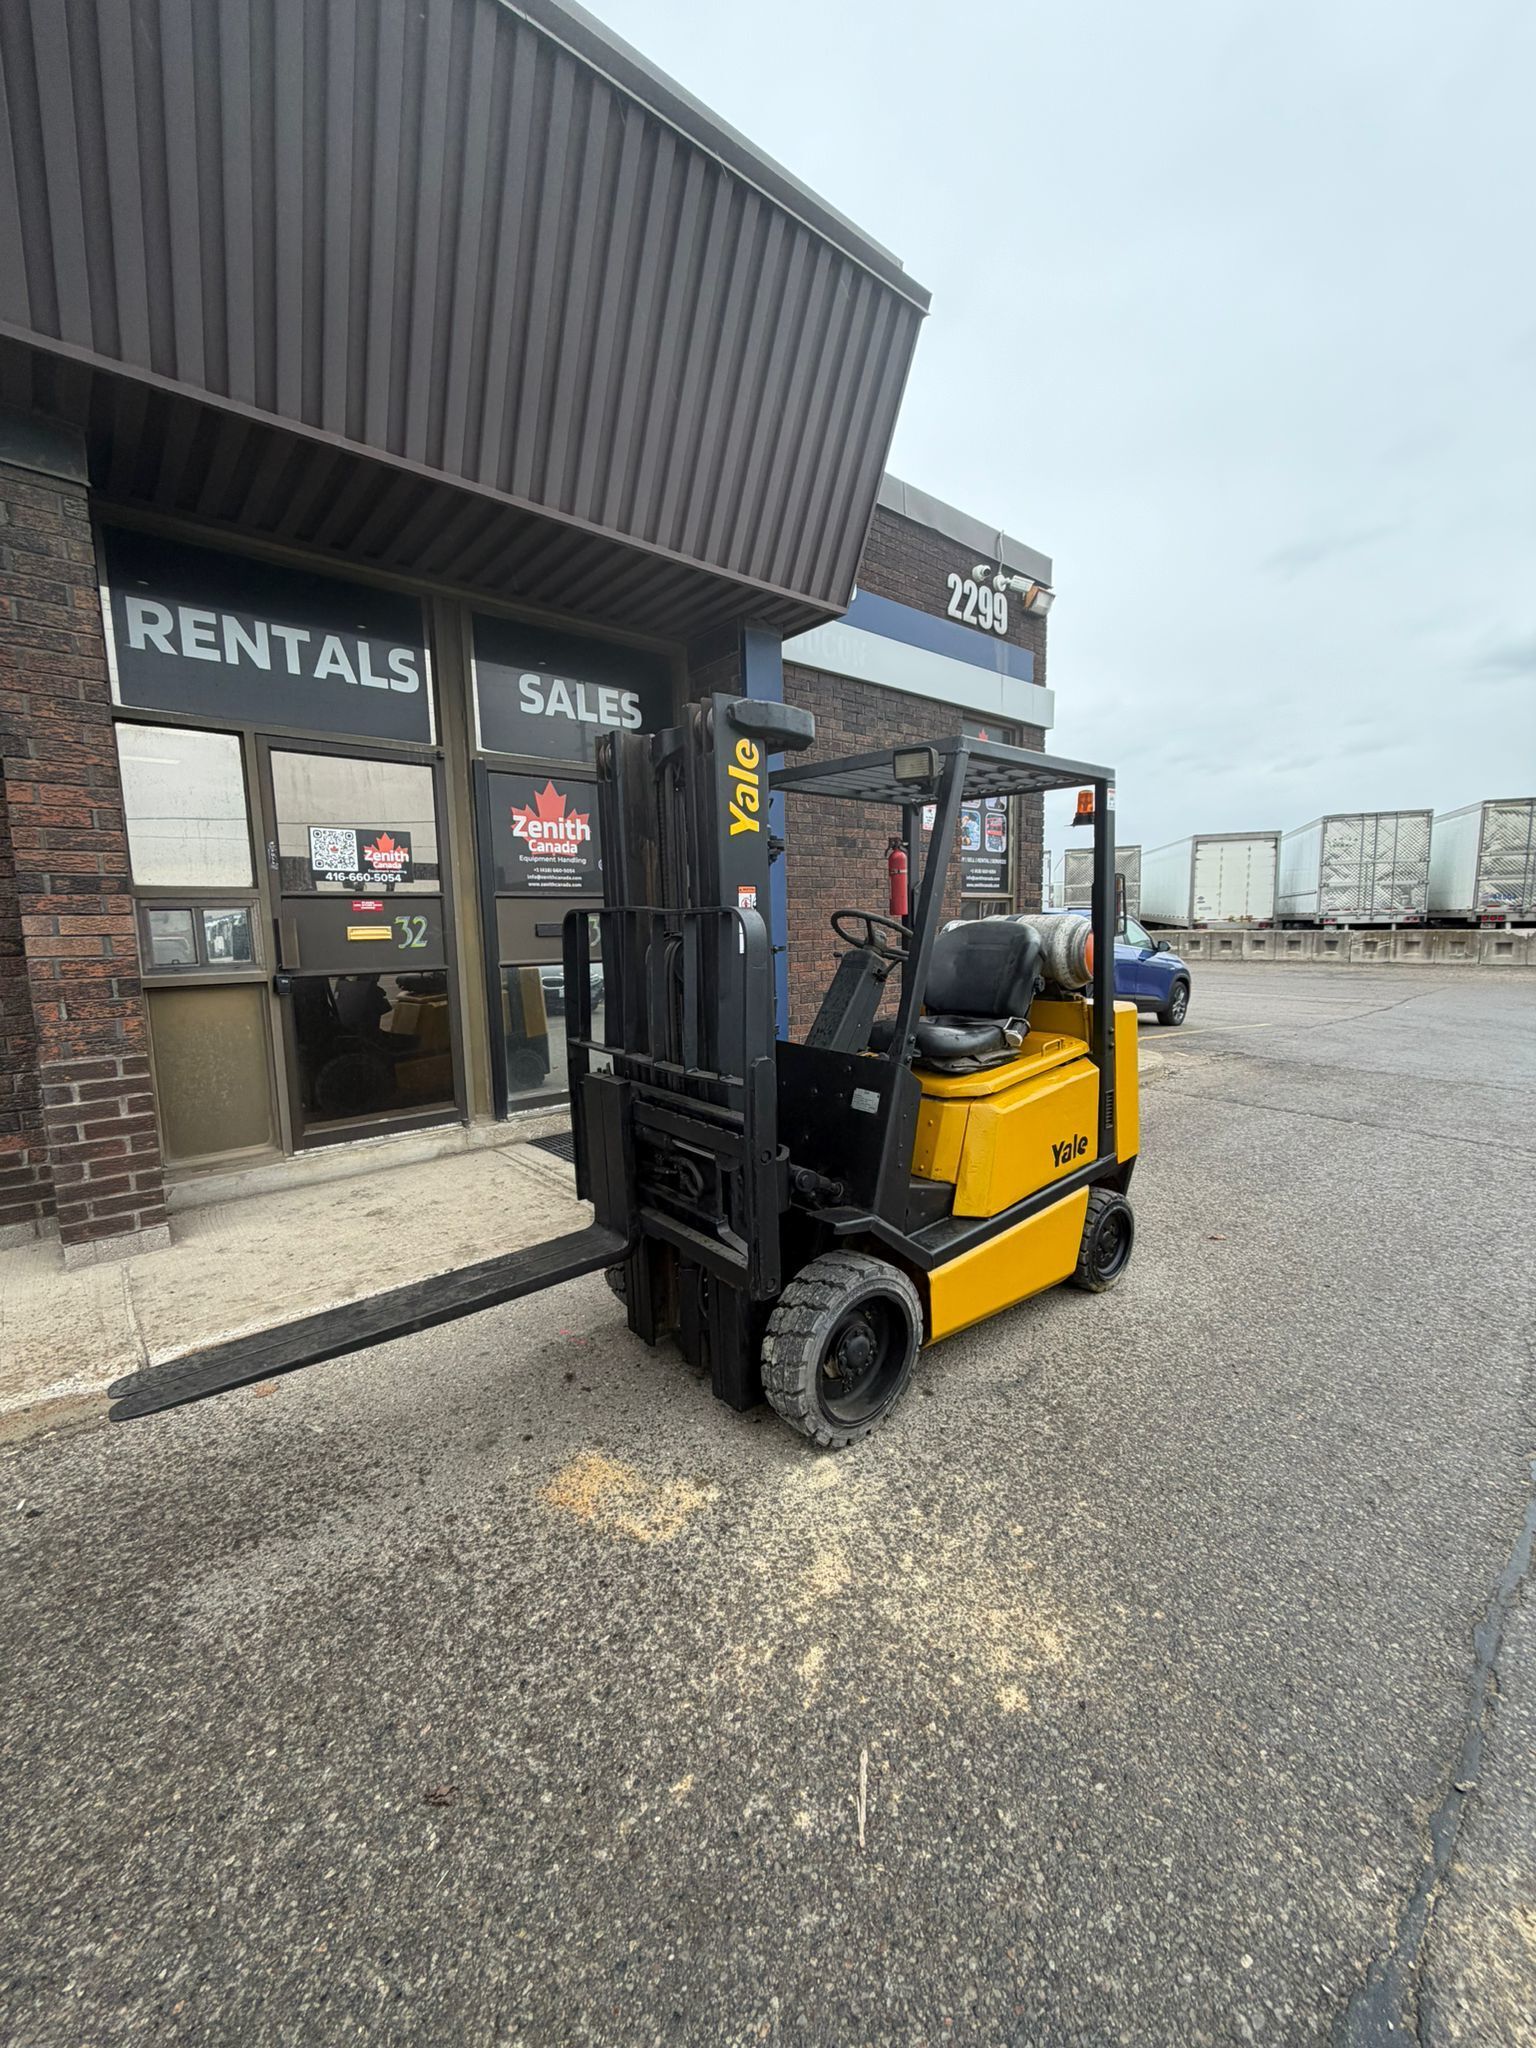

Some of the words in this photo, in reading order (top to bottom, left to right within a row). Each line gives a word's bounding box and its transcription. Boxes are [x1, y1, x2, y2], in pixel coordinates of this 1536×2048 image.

[947, 572, 1008, 635] 2299
[124, 595, 420, 694] RENTALS
[518, 673, 643, 730] SALES
[728, 738, 760, 836] Yale
[512, 815, 590, 840] Zenith
[363, 849, 410, 862] Zenith
[519, 855, 556, 863] Equipment
[557, 856, 587, 865] Handling
[528, 840, 578, 853] Canada
[325, 872, 402, 882] 416-660-5054
[372, 861, 402, 869] Canada
[394, 915, 428, 949] 32
[1051, 1133, 1089, 1169] Yale
